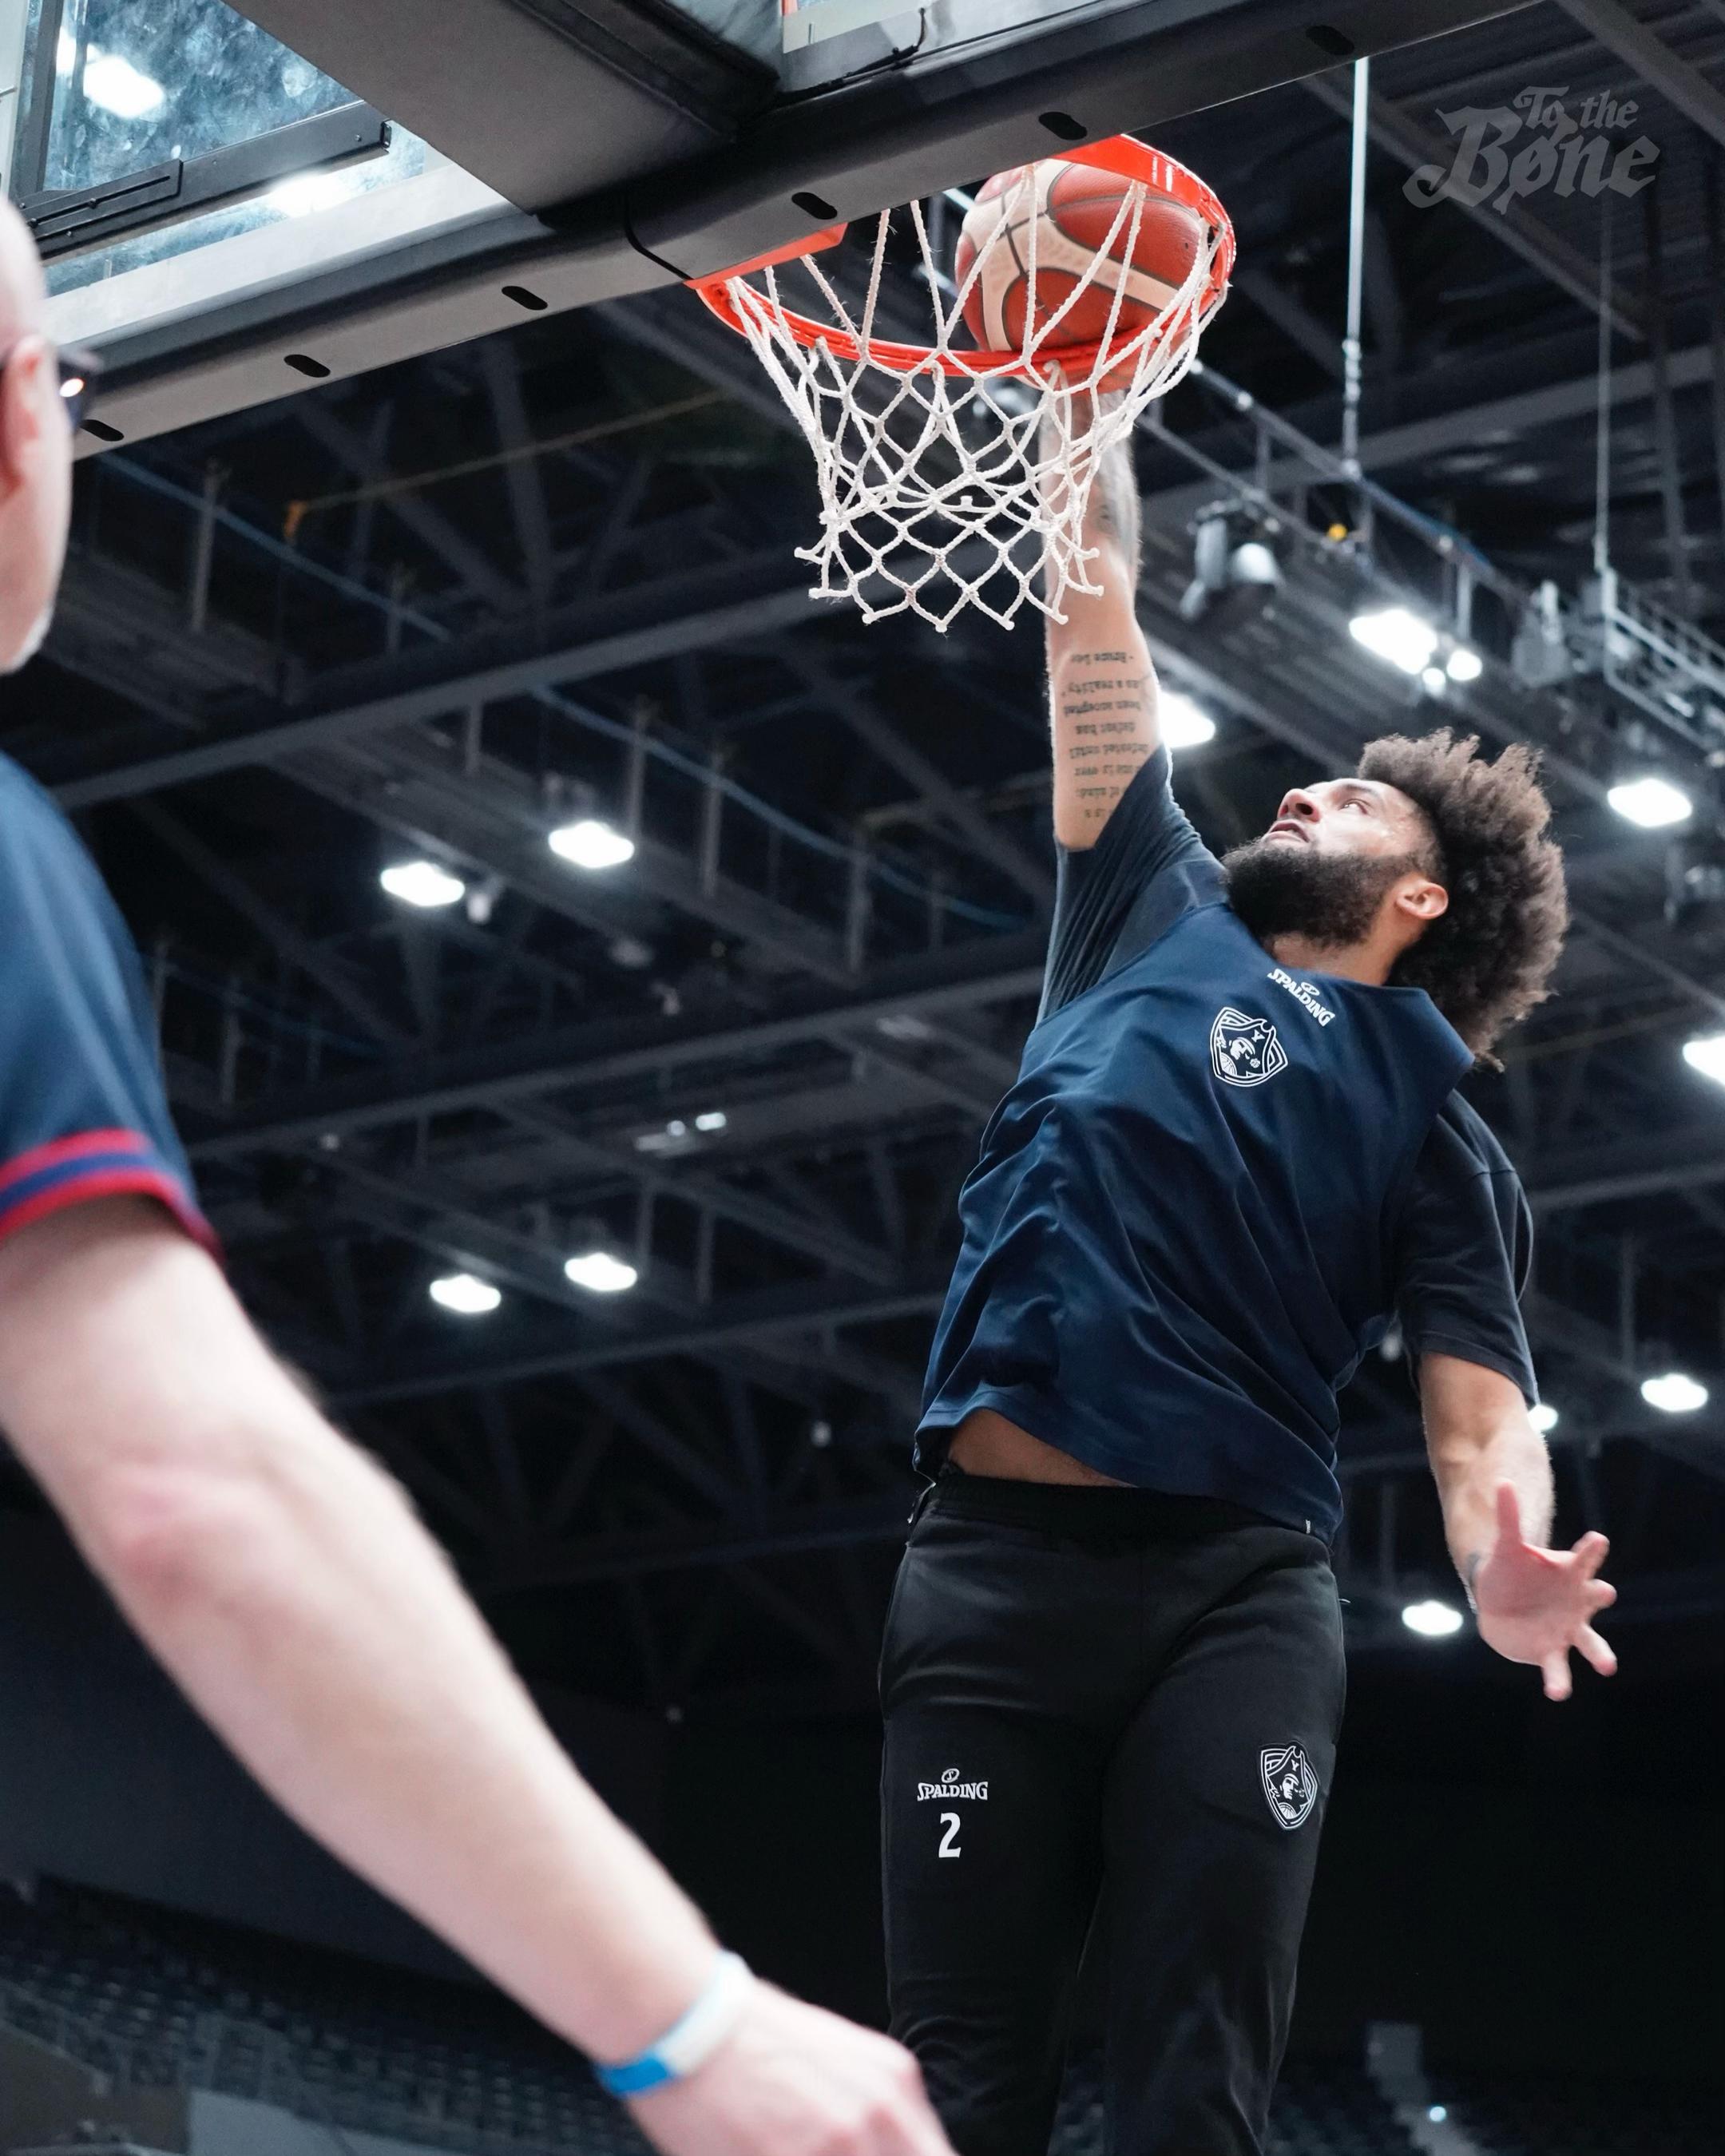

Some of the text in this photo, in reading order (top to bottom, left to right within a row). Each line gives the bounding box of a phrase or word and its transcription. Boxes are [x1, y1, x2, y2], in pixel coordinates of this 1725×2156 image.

[1267, 968, 1335, 1027] SPALDING
[917, 1781, 989, 1801] SPALDING
[938, 1812, 962, 1858] 2
